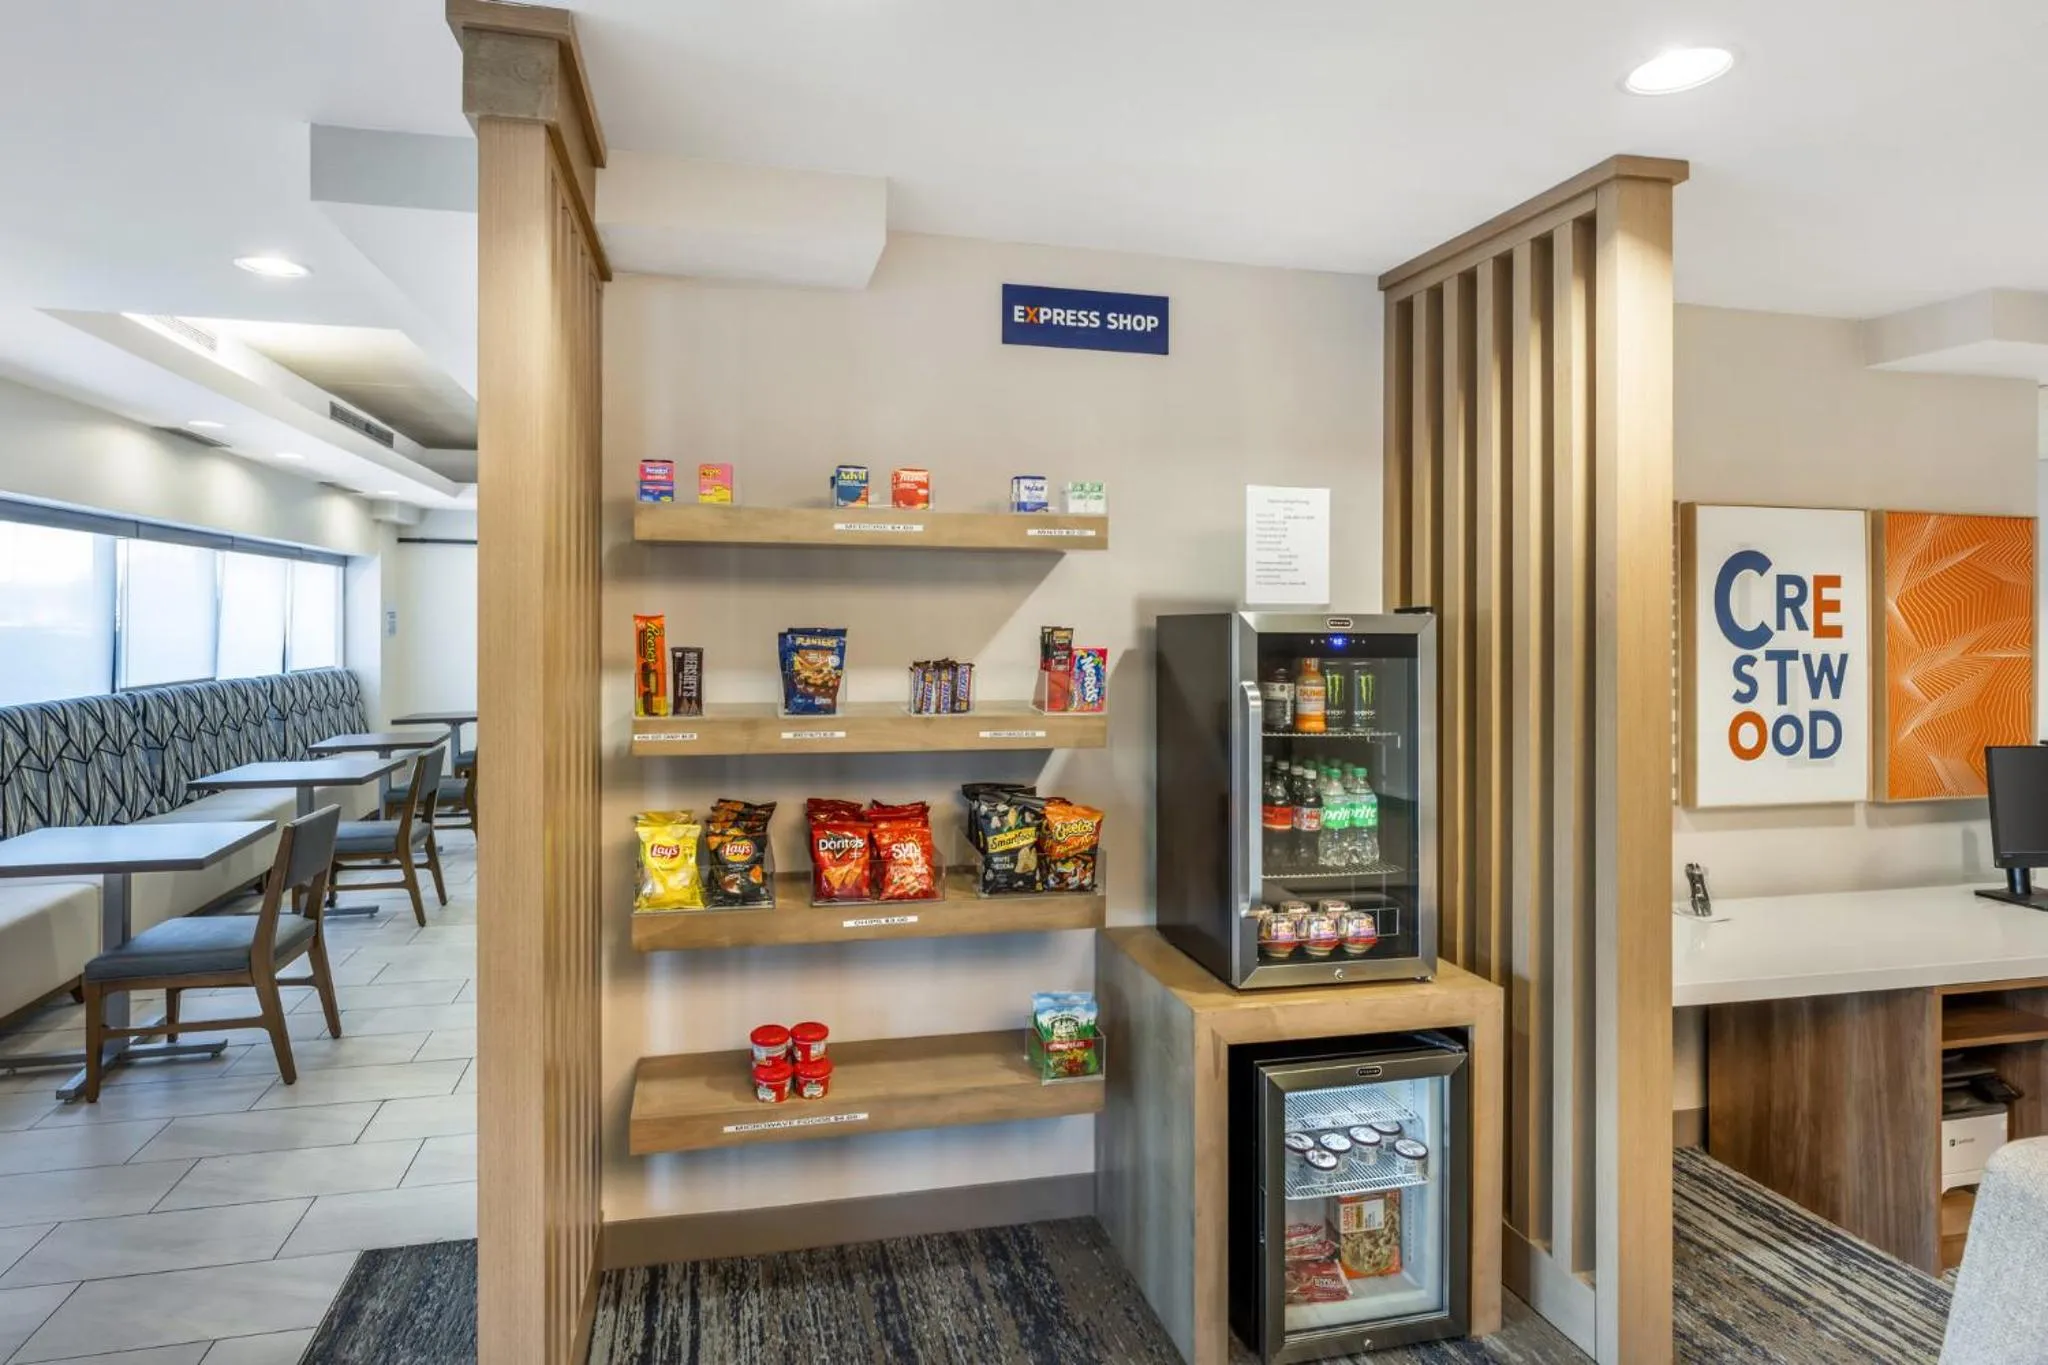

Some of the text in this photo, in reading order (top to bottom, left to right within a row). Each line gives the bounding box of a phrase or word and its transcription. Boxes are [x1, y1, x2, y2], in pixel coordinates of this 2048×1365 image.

[1014, 305, 1159, 332] EXPRESS SHOP
[839, 471, 865, 480] Advil
[796, 635, 838, 647] PLANTERS
[1055, 820, 1094, 840] Cheetos
[819, 837, 864, 850] Doritos
[991, 830, 1034, 850] Smartfood
[652, 844, 679, 859] Lay's
[725, 843, 752, 855] Lay's
